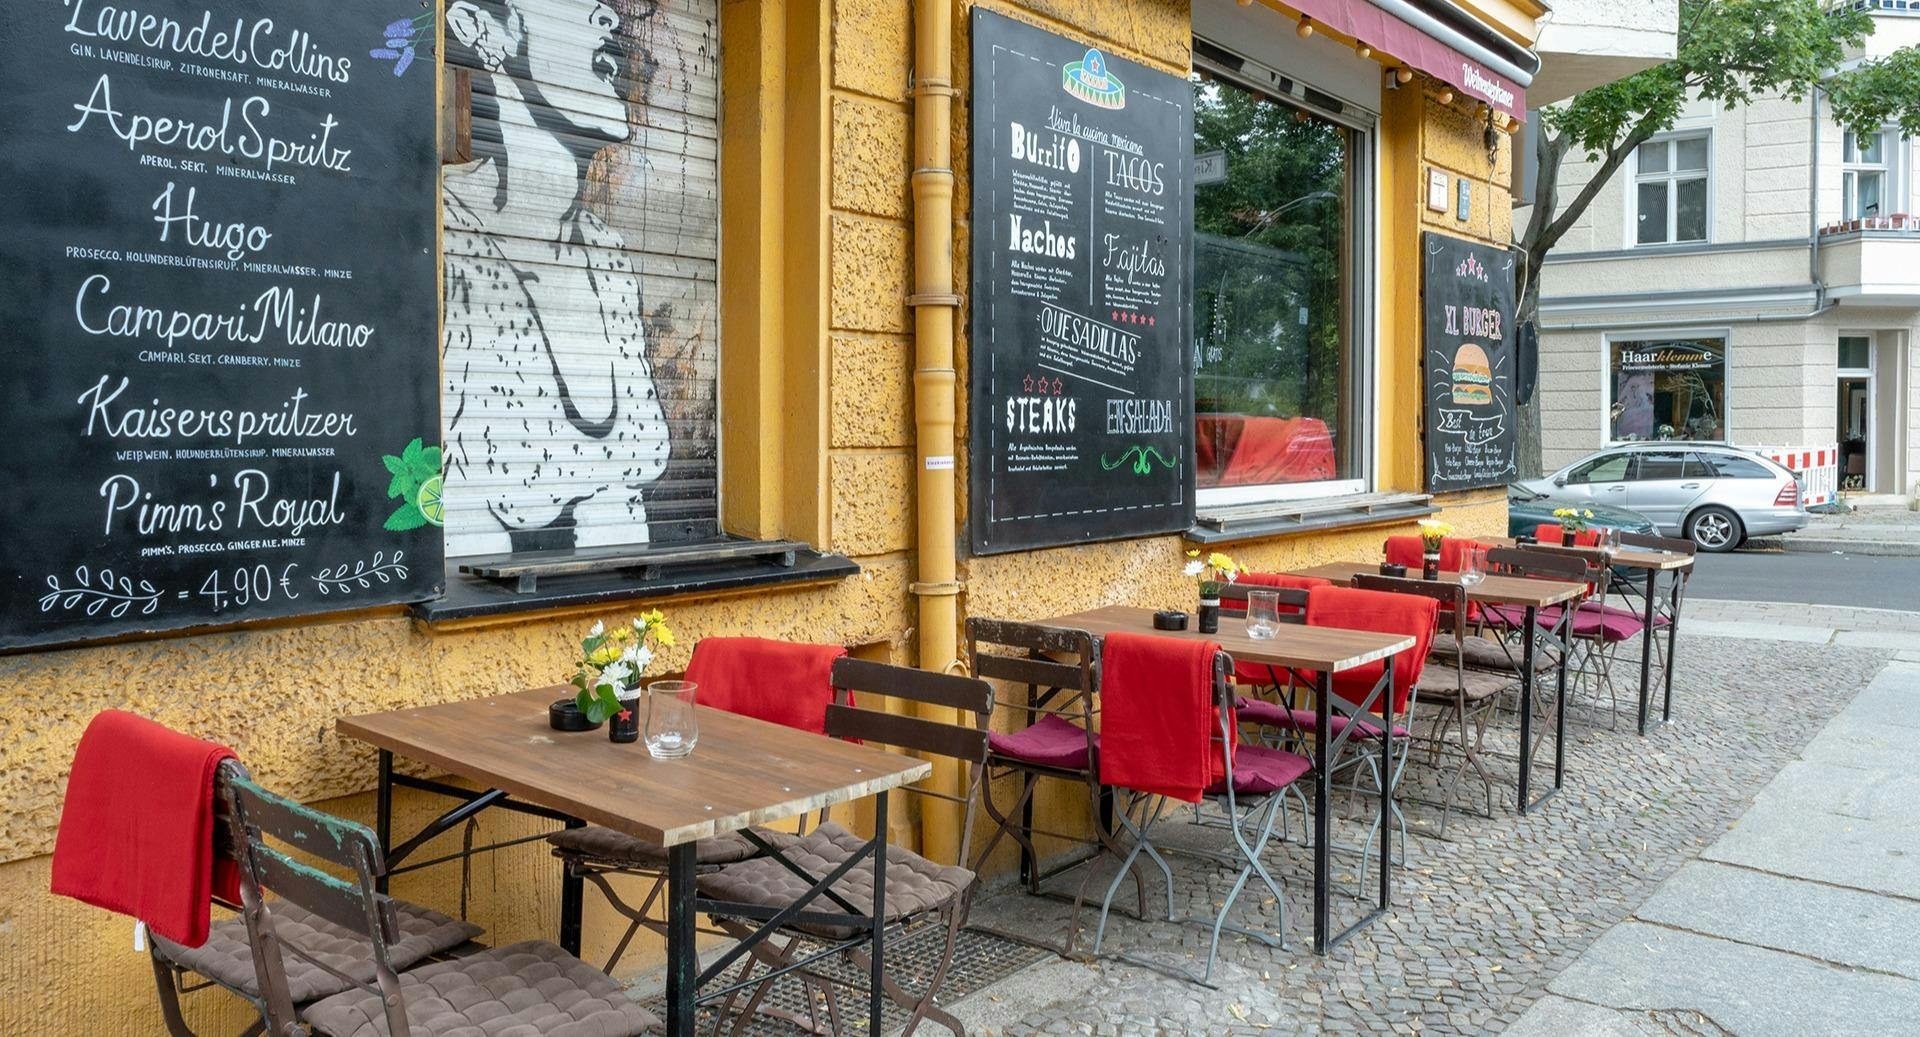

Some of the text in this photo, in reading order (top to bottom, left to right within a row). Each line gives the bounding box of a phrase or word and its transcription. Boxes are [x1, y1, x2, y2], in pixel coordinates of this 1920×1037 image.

[64, 0, 351, 83] Lavendel Collins
[257, 77, 331, 97] MINERALWASSER
[67, 73, 351, 171] Aperol Spritz
[217, 165, 295, 184] MINERALWASSER
[1104, 149, 1164, 196] TACOS
[152, 182, 272, 259] Hugo
[1009, 213, 1076, 260] Nachos
[325, 269, 352, 278] MINZE
[1103, 233, 1165, 284] Fajitas
[76, 274, 374, 348] Campari Milano
[1445, 304, 1502, 340] XL BURGER
[1041, 306, 1137, 364] QUESADILLAS
[274, 358, 300, 367] MINZE
[77, 375, 357, 444] Kaiserspritzer
[1006, 396, 1076, 433] STEAKS
[1106, 399, 1173, 434] ENSALADA
[1446, 412, 1462, 428] Best
[272, 448, 335, 457] MINERALWASSER
[100, 469, 345, 536] Pimm's Royal
[228, 540, 260, 550] GINGER
[282, 538, 305, 546] MINZE
[199, 565, 271, 607] 4,90
[280, 563, 299, 599] €
